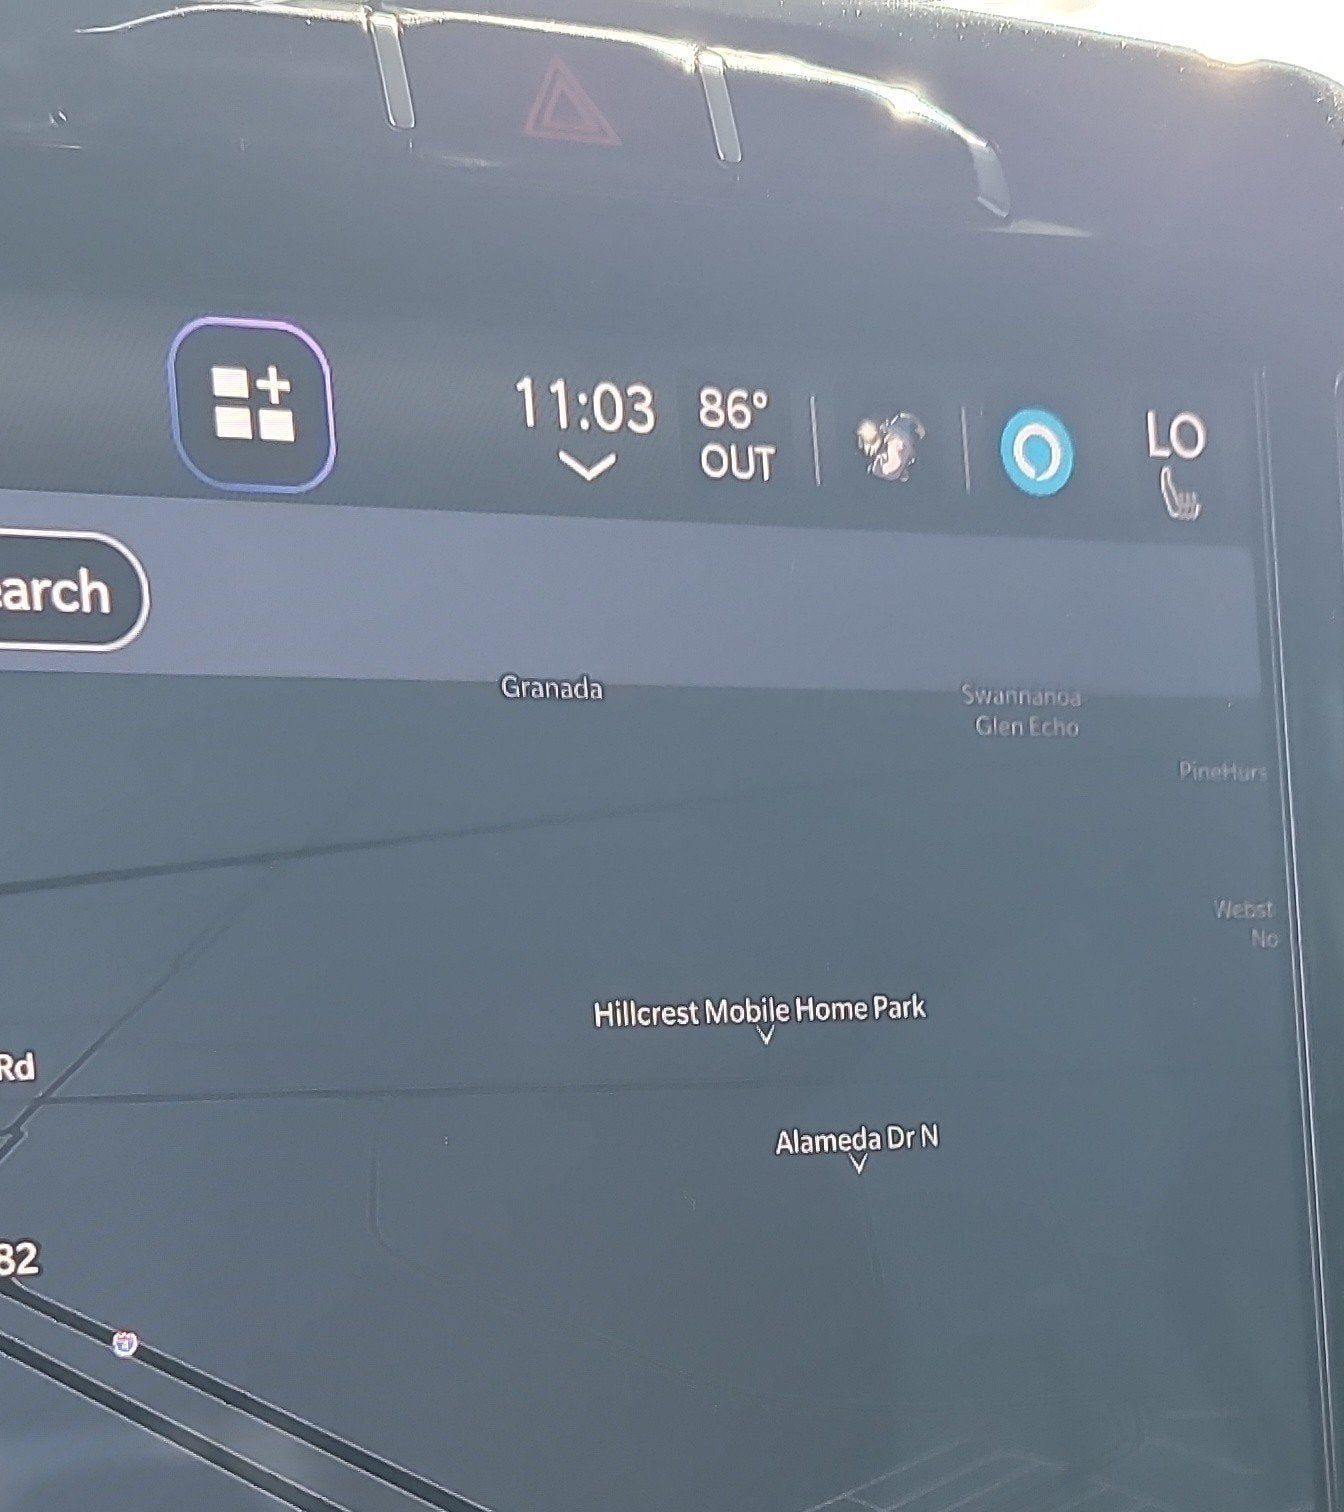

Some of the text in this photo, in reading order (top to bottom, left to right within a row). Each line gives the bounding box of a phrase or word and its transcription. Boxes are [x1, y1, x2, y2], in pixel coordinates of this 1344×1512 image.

[516, 376, 656, 434] 11:03
[1147, 410, 1207, 459] LO
[700, 443, 776, 482] OUT
[501, 674, 604, 700] Granada
[961, 683, 1082, 707] Swannanoa
[975, 714, 1080, 738] Glen Echo
[594, 993, 928, 1028] Hillcrest Mobile Home Park
[775, 1123, 940, 1156] Alameda Dr N
